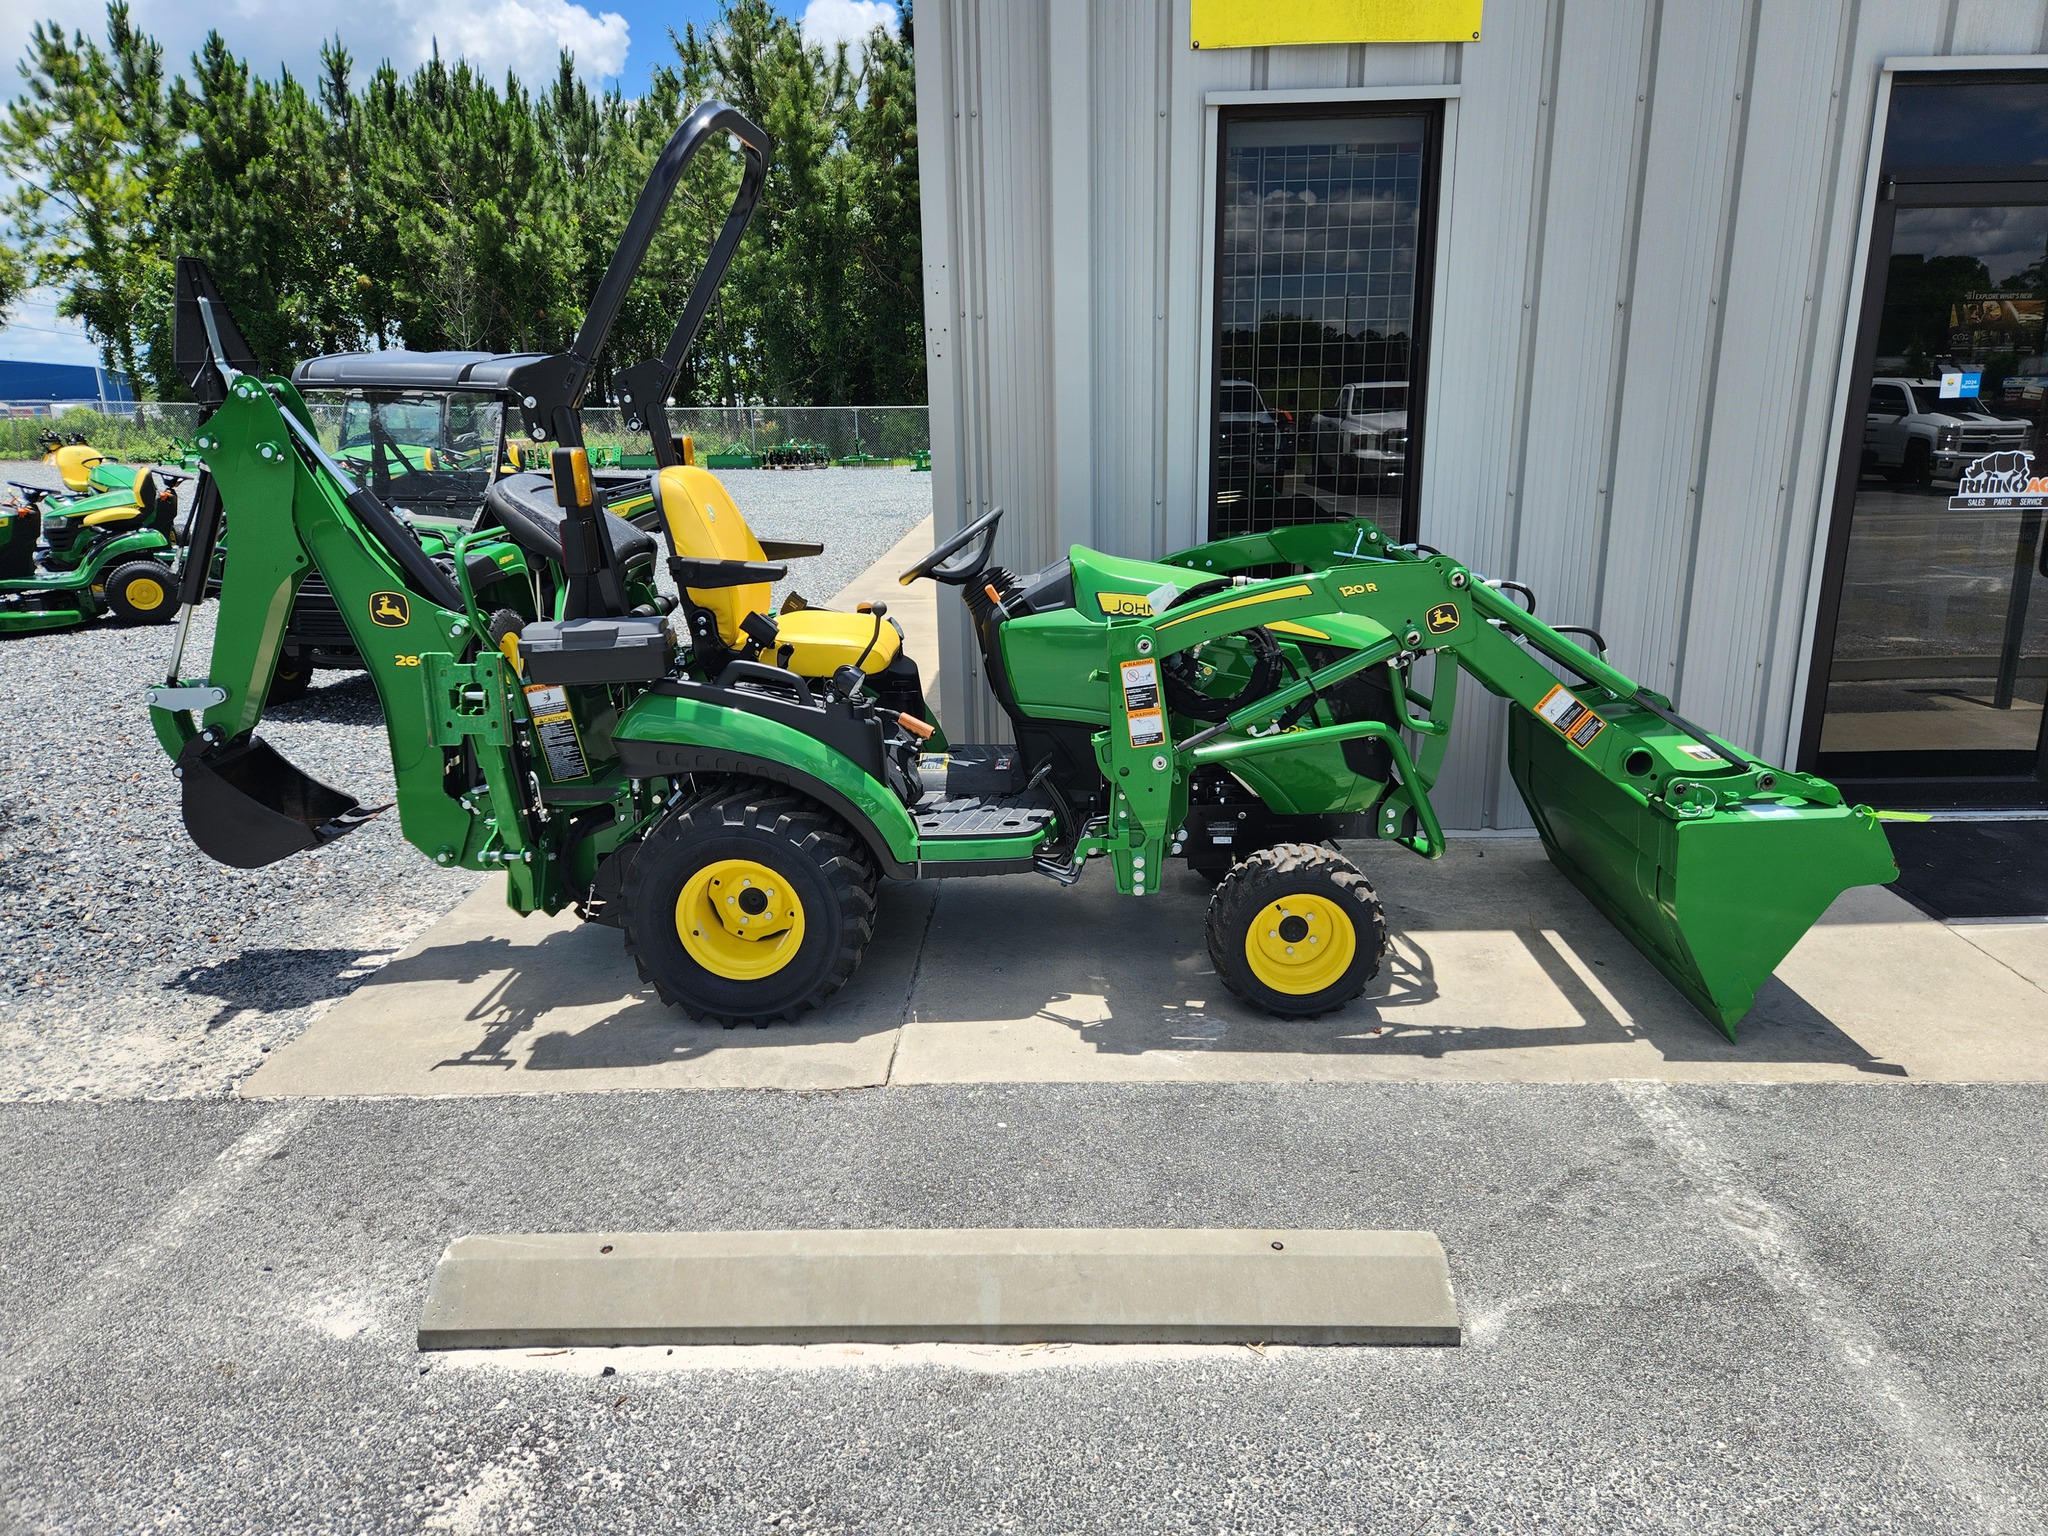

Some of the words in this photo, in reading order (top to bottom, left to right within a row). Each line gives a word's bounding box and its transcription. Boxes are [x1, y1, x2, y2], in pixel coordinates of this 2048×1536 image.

[1967, 498, 1986, 507] SALES
[1993, 498, 2013, 507] PARTS
[2019, 497, 2044, 506] SERVICE
[1127, 658, 1154, 668] WARNING
[543, 714, 568, 724] CAUTION
